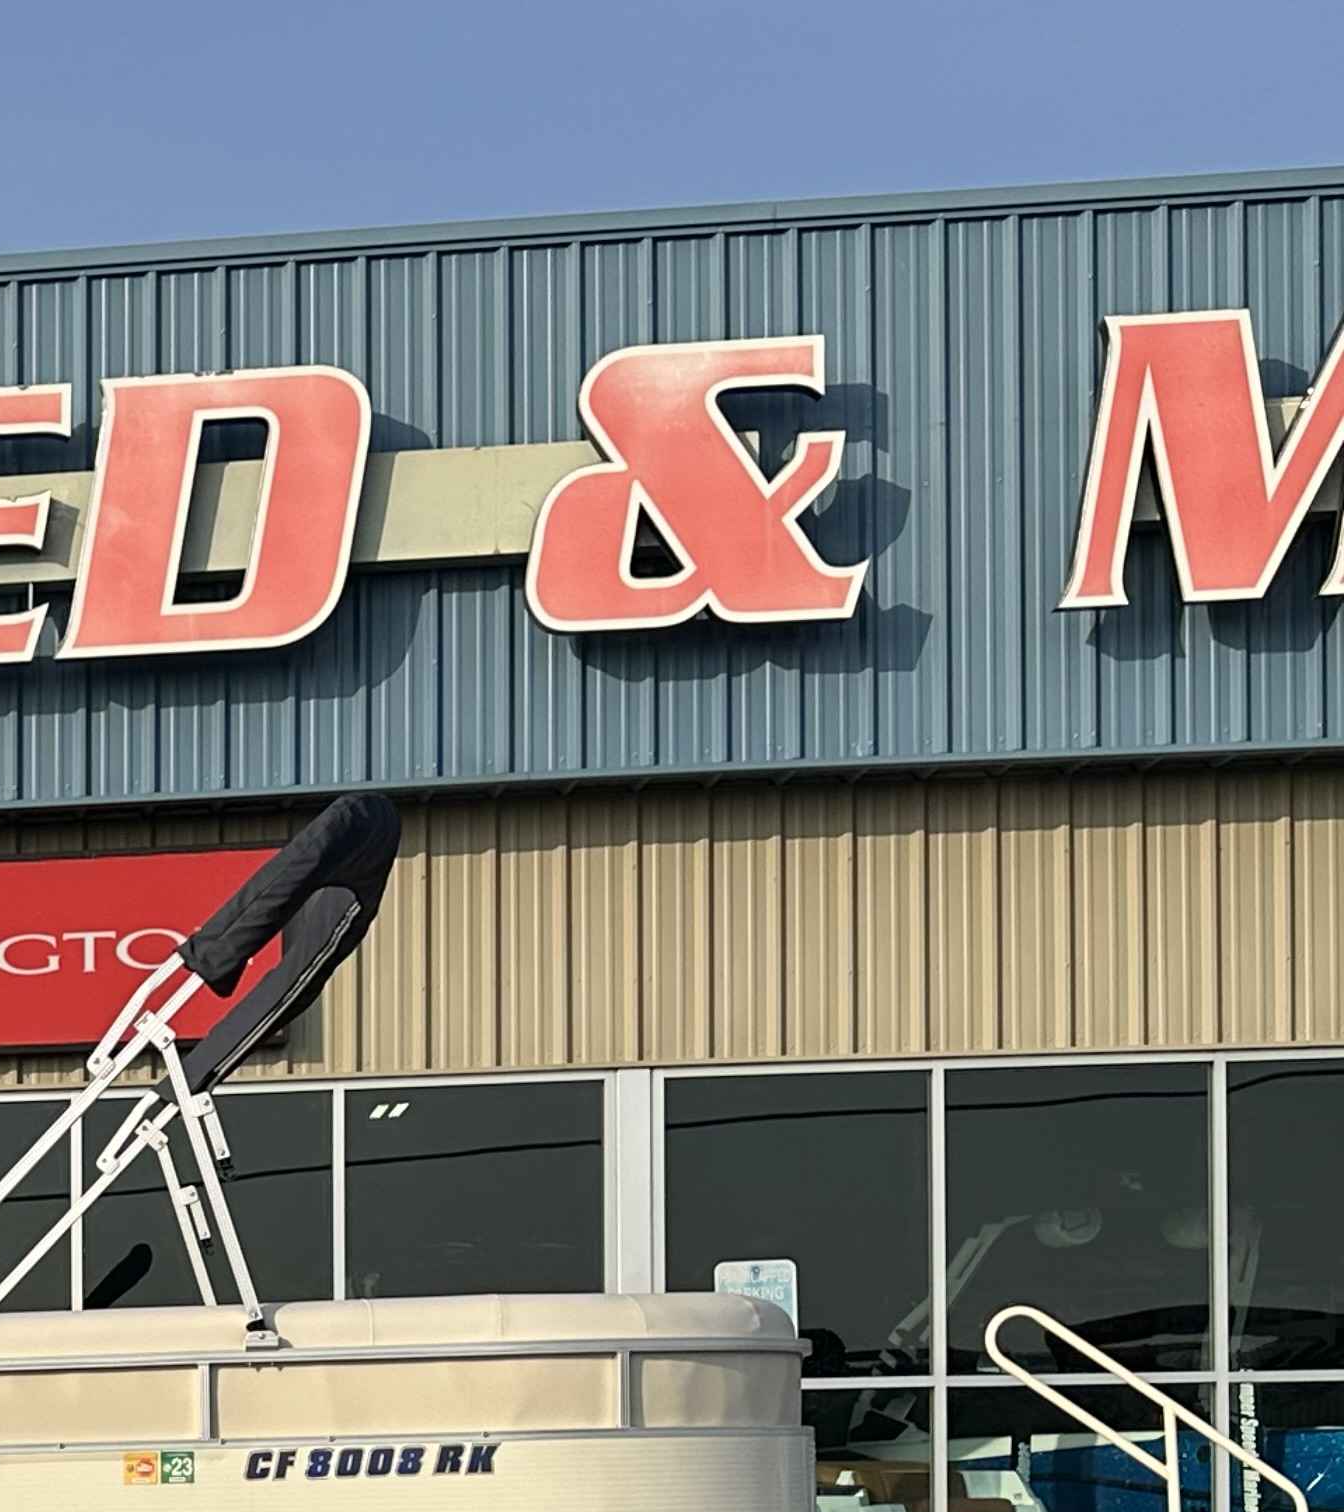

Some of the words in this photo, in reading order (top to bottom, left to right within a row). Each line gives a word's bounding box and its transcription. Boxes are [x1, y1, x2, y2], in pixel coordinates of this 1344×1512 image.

[525, 334, 870, 634] &
[170, 1456, 193, 1476] 23
[245, 1449, 297, 1481] CF
[304, 1446, 427, 1479] 8008
[432, 1442, 502, 1476] RK
